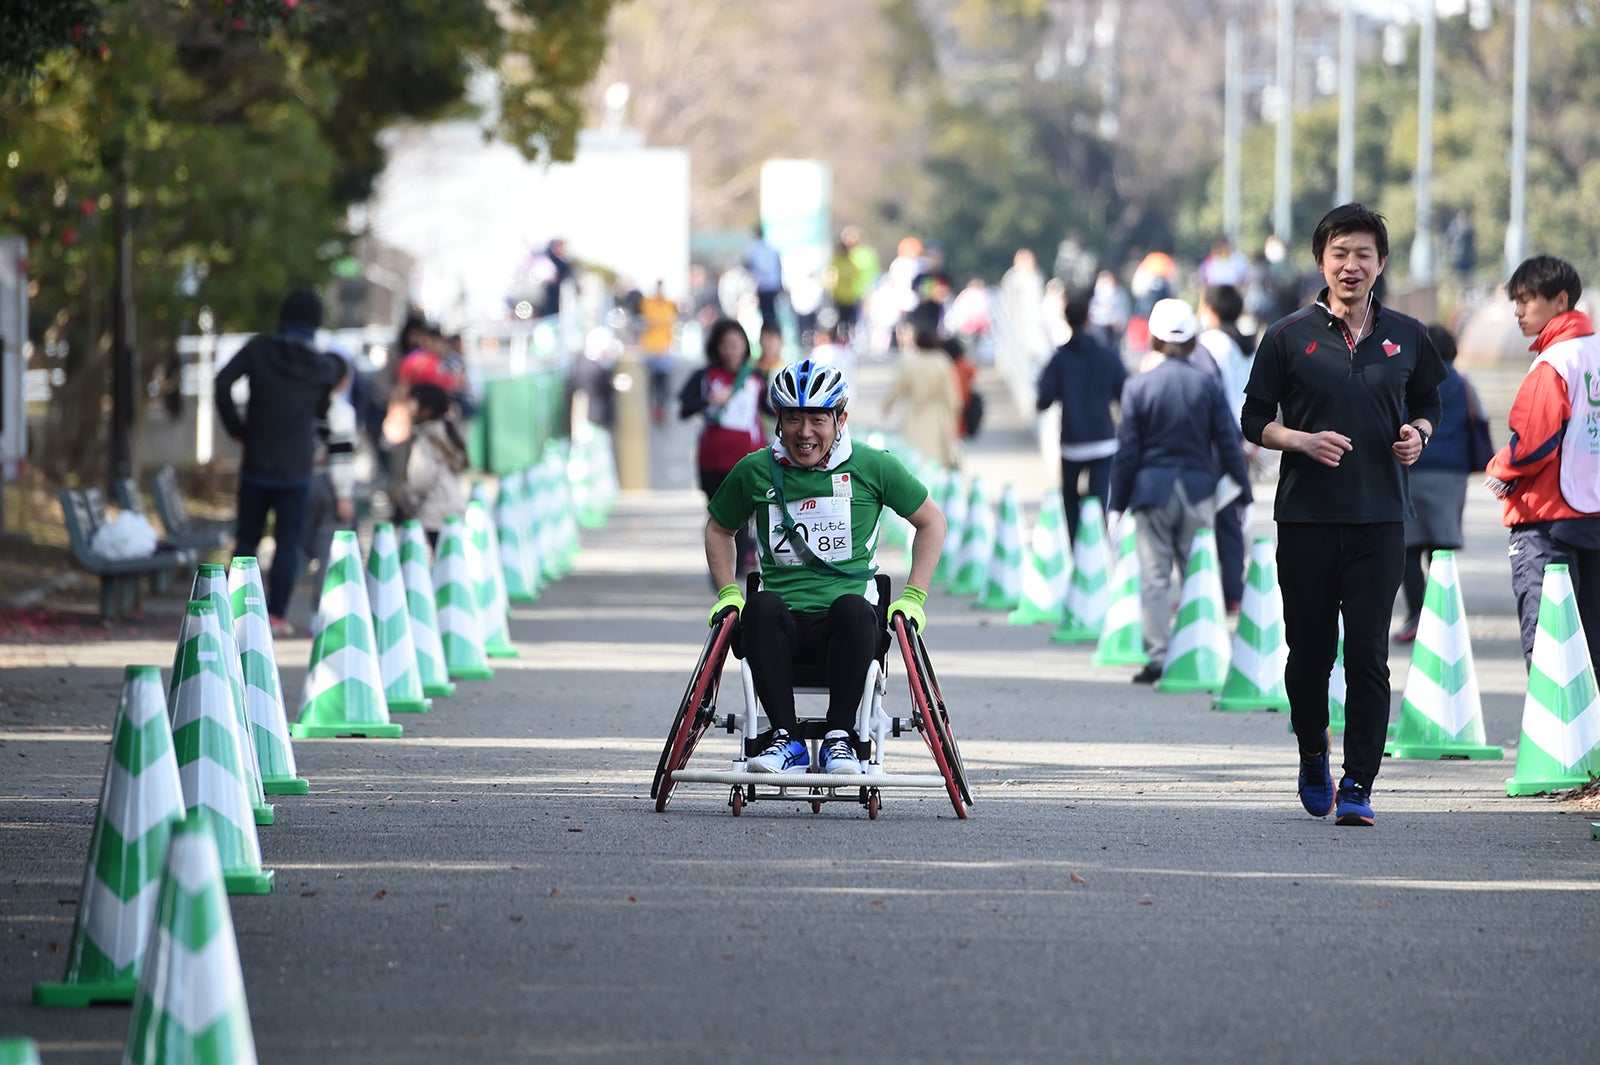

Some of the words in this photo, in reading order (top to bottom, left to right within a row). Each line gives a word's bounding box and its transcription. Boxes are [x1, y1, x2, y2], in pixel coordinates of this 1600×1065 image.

[800, 499, 816, 511] JTB
[811, 521, 846, 532] よしもと
[818, 536, 847, 552] 8区
